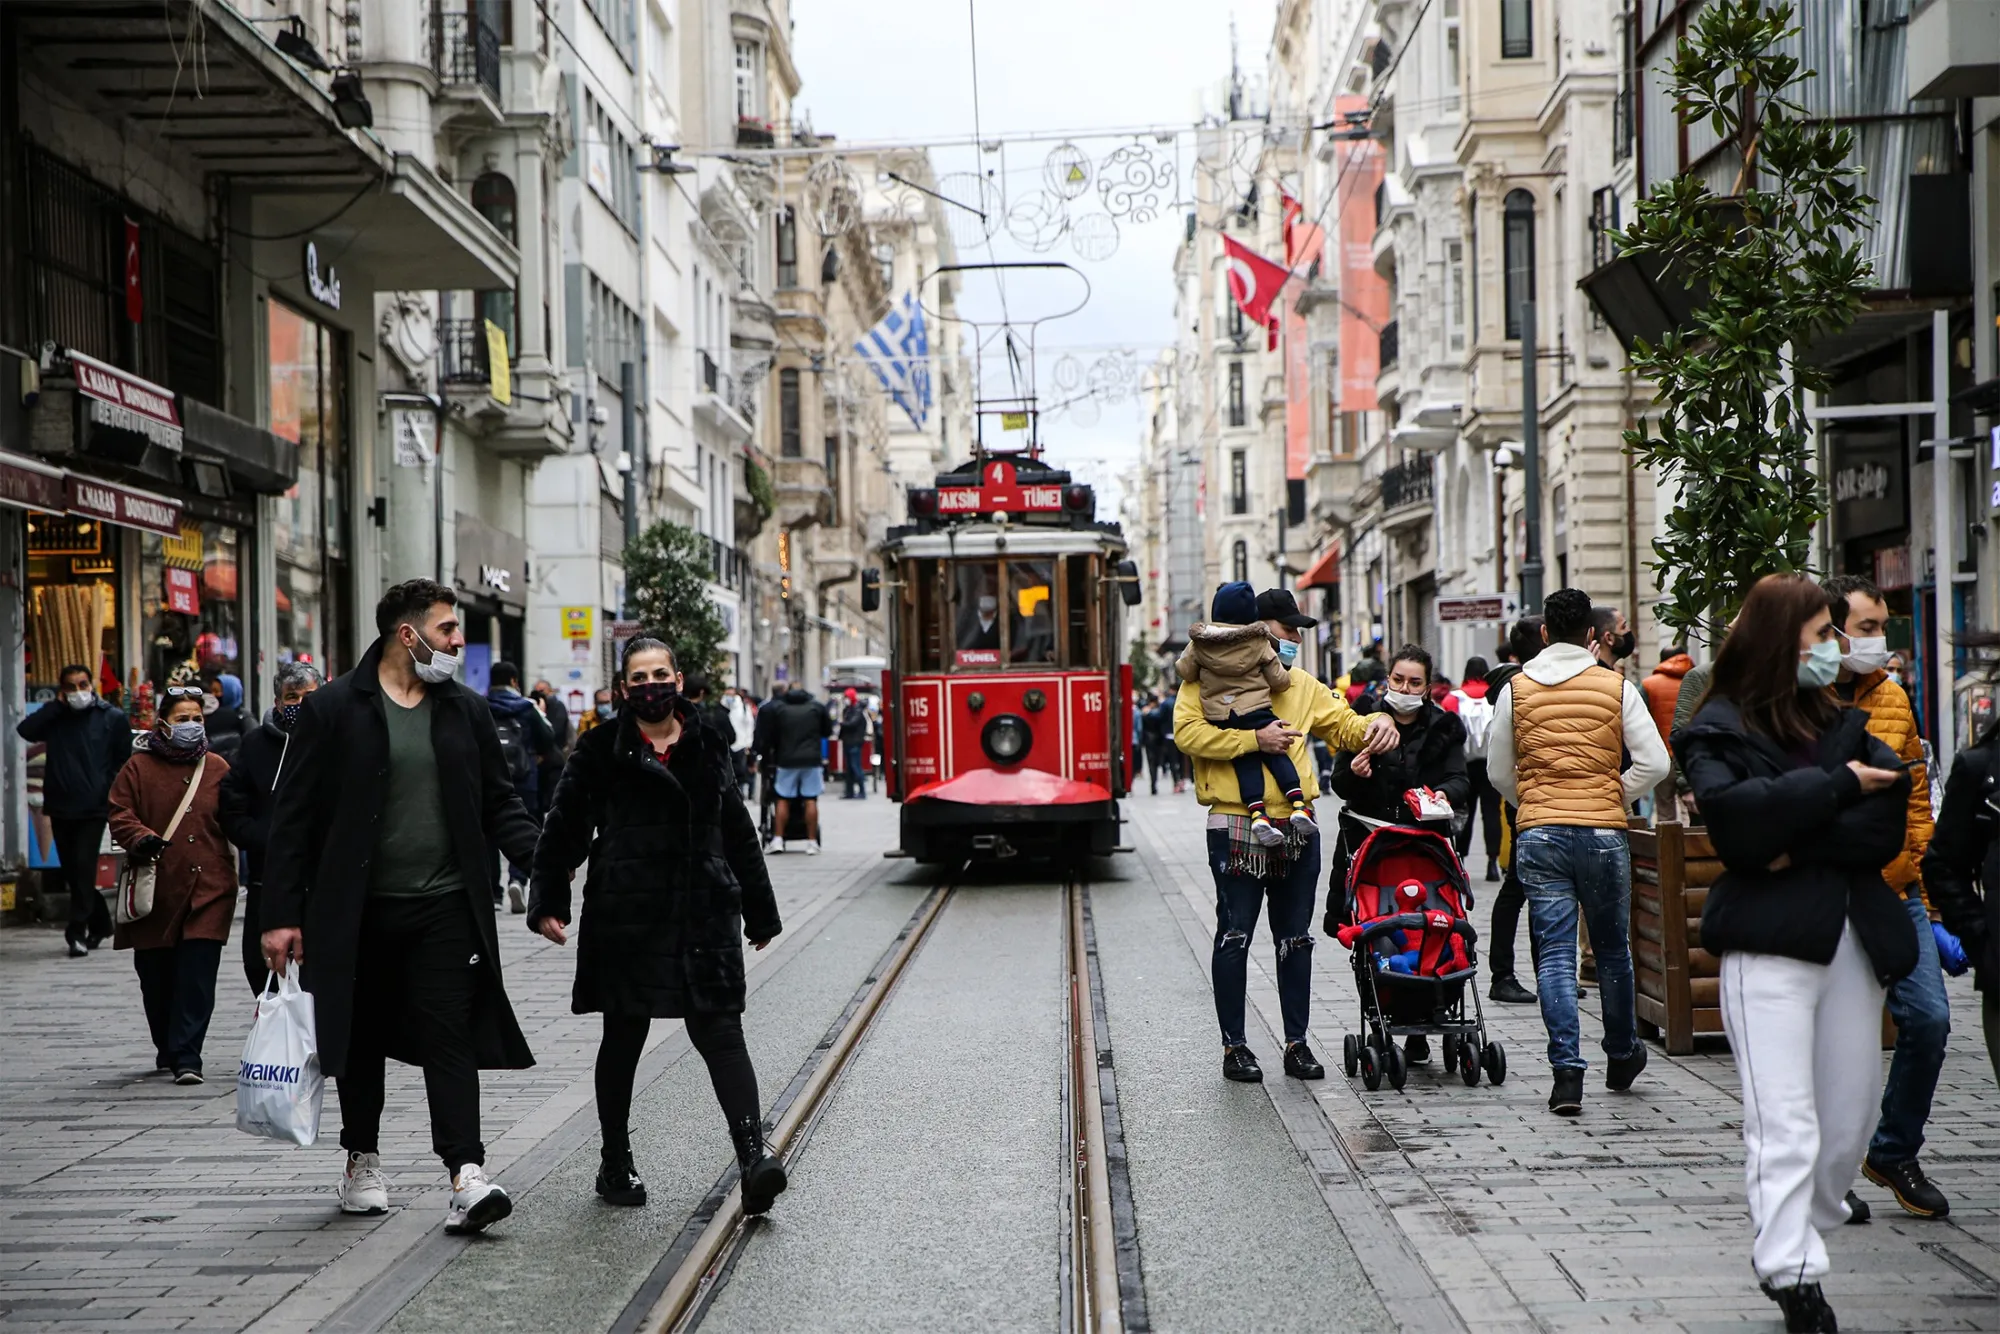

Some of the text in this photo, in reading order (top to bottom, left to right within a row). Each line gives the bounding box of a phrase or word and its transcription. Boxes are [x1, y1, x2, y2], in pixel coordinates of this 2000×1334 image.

[992, 463, 1004, 484] 4
[962, 650, 997, 662] TÜNEL
[909, 697, 929, 718] 115
[1082, 692, 1103, 713] 115
